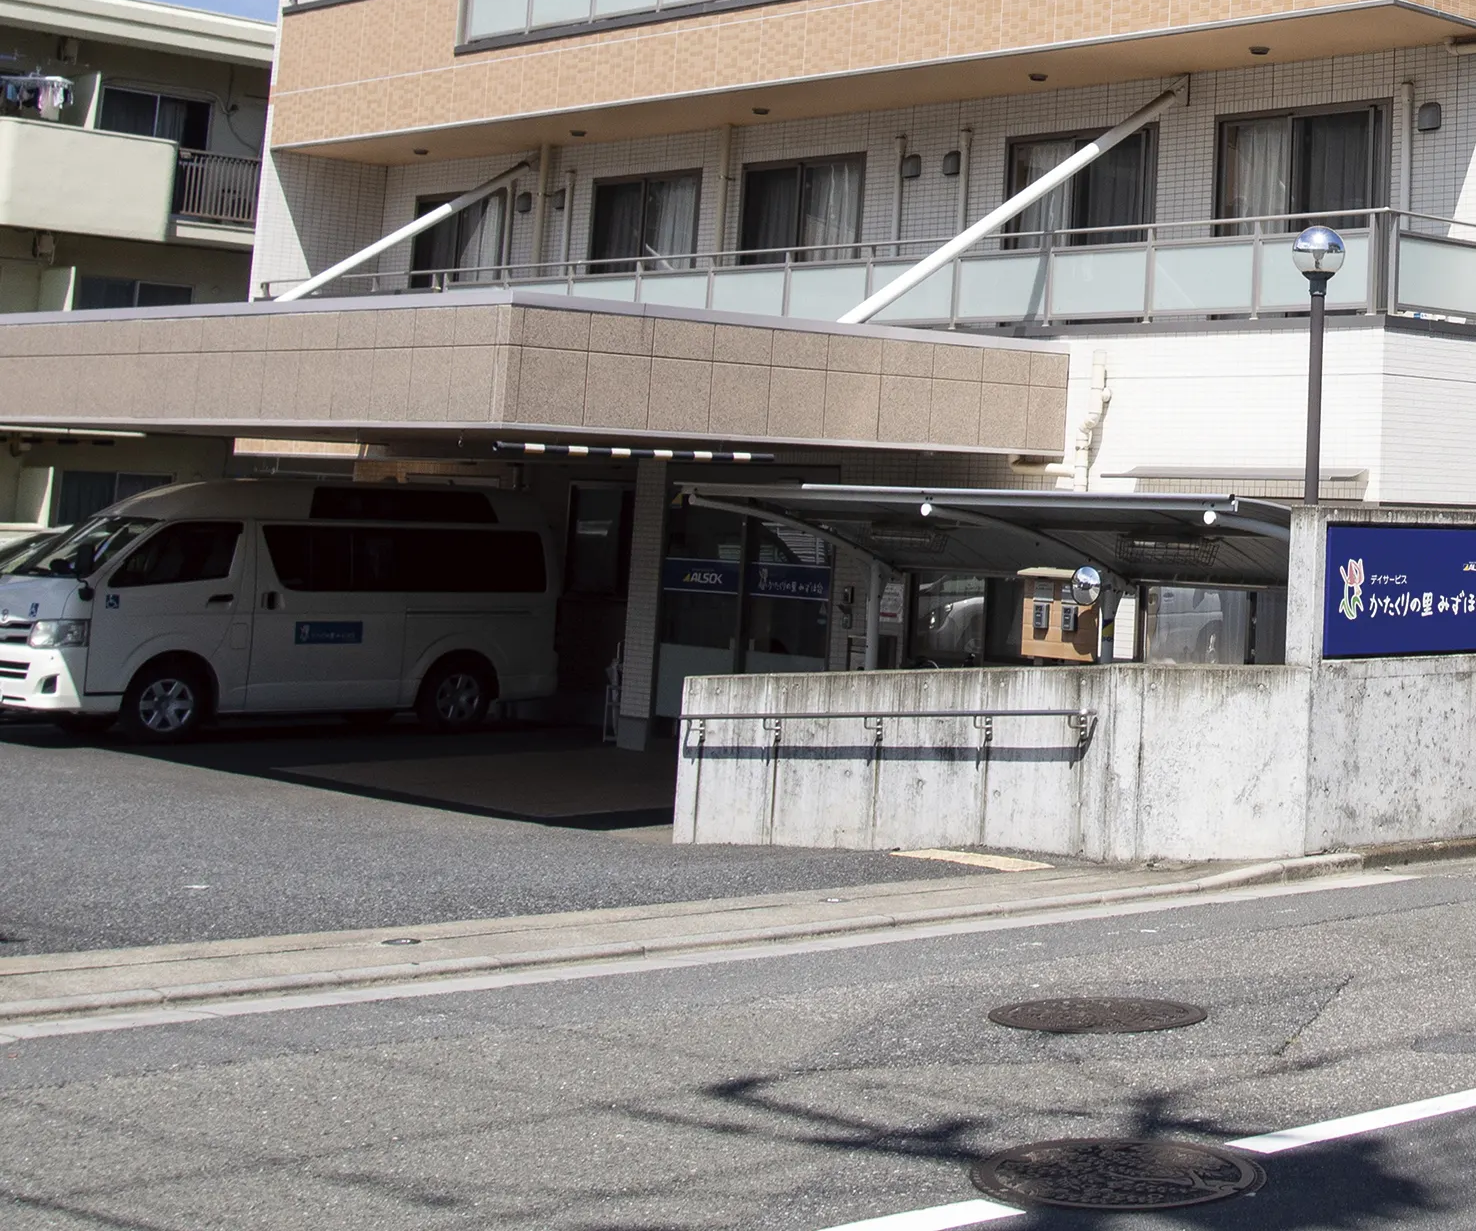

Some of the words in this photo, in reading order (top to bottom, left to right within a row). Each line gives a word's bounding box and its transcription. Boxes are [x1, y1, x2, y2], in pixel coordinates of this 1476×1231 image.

[690, 572, 723, 585] ALSOK
[1370, 574, 1408, 585] デイサービス
[1369, 591, 1434, 618] かたくりの里
